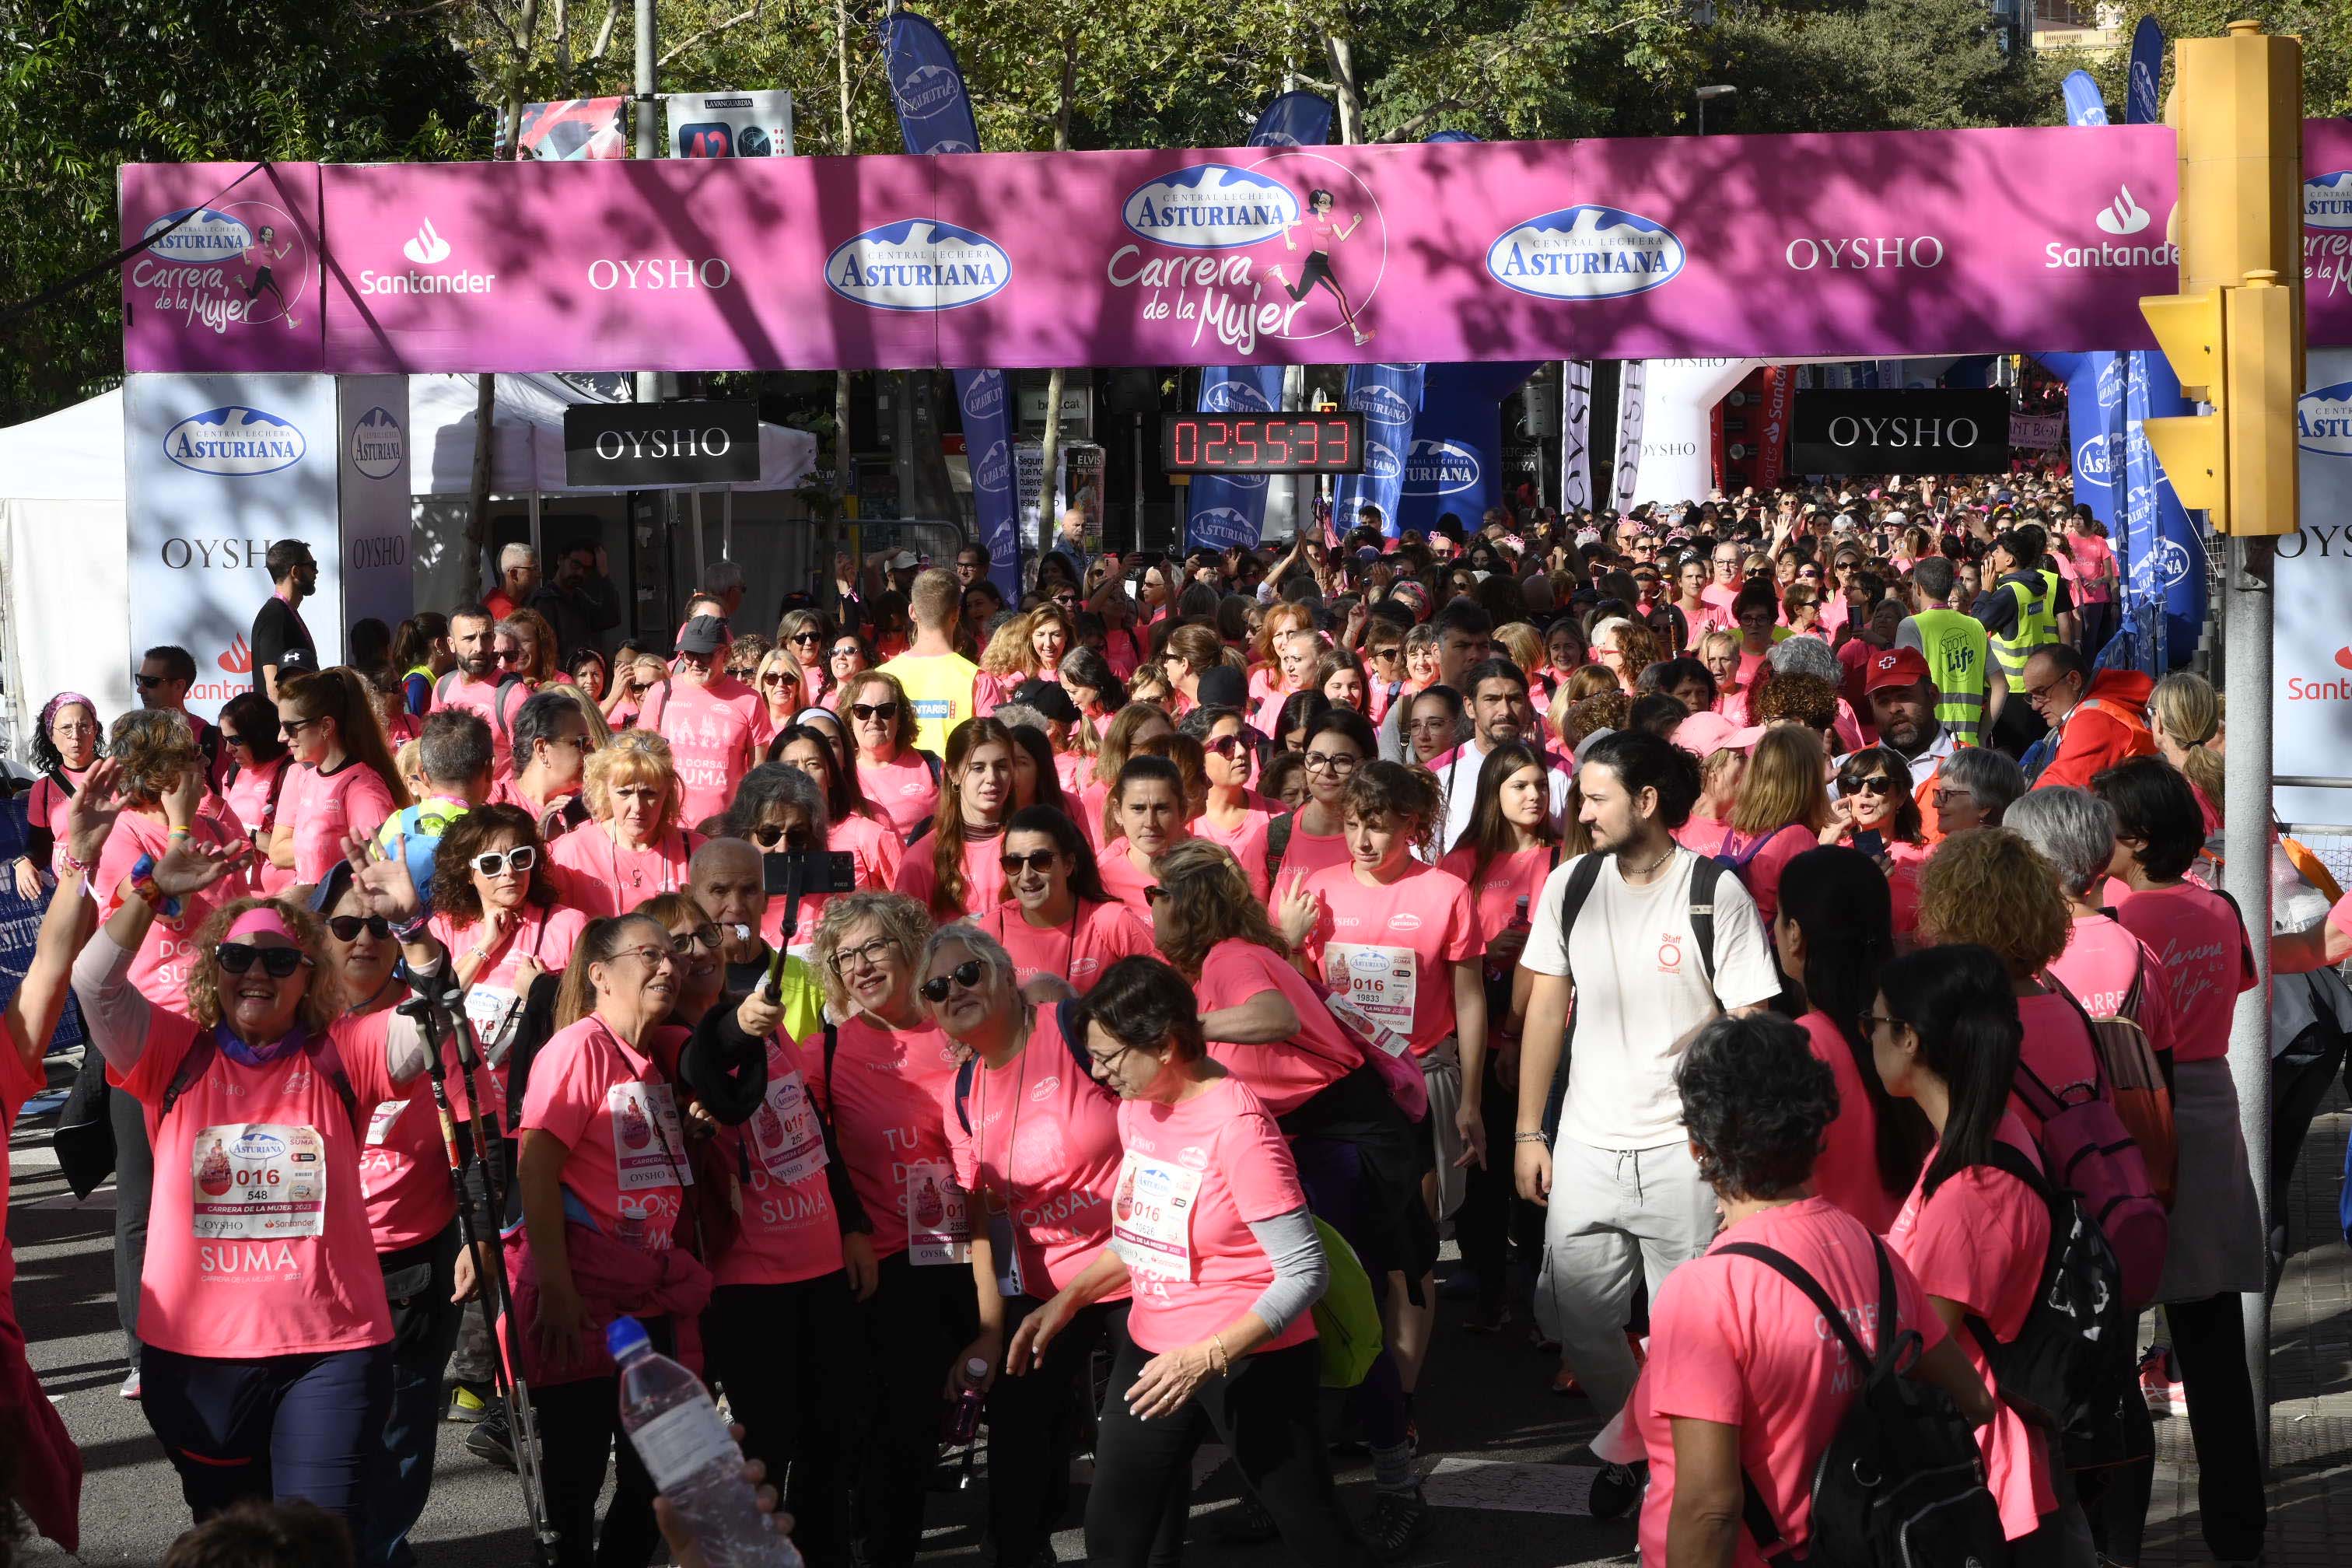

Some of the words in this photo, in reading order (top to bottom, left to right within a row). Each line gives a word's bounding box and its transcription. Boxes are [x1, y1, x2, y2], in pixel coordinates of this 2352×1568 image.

[1164, 193, 1218, 202] CENTRAL
[1223, 192, 1281, 201] LECHERA
[2304, 201, 2352, 215] STUR
[1136, 196, 1283, 227] ASTURIANA
[1532, 238, 1594, 248] CENTRAL
[1599, 236, 1663, 247] LECHERA
[1786, 235, 1944, 270] OYSHO
[867, 250, 926, 259] CENTRAL
[932, 249, 991, 259] LECHERA
[1503, 241, 1669, 277] ASTURIANA
[2045, 241, 2179, 268] Santande
[132, 259, 224, 288] Carrera
[587, 257, 731, 290] OYSHO
[839, 253, 997, 287] ASTURIANA
[1108, 244, 1253, 288] Carrera
[2318, 257, 2332, 278] la
[360, 270, 495, 295] Santander
[155, 290, 172, 310] de
[176, 287, 188, 310] la
[185, 285, 259, 334] Mujer
[1143, 290, 1171, 320] de
[1176, 289, 1195, 320] la
[1192, 280, 1307, 355] Mujer
[595, 427, 730, 460] OYSHO
[1175, 422, 1349, 464] 02:55:33
[1566, 360, 1591, 508] OYSH
[1828, 416, 1979, 448] OYSHO
[174, 431, 296, 459] ASTURIANA
[355, 434, 400, 462] ASTURIANA
[1077, 454, 1101, 465] ELVIS
[1020, 468, 1032, 478] que
[1020, 478, 1044, 488] quiere
[1195, 518, 1254, 547] ASTURIANA
[161, 537, 272, 569] OYSH
[352, 535, 404, 570] OYSHO
[1941, 632, 1969, 655] Sport
[1947, 647, 1974, 673] Life
[912, 704, 947, 715] NTARIS
[686, 758, 728, 769] DORSAL
[683, 768, 727, 786] UMA
[1481, 879, 1510, 890] YSHO
[1661, 933, 1682, 944] Staff
[1353, 978, 1384, 992] 016
[1356, 993, 1380, 1003] 19833
[2081, 989, 2126, 1010] ARRE
[233, 1143, 282, 1153] ASTURIANA
[883, 1125, 919, 1152] TU
[236, 1169, 280, 1186] 016
[630, 1170, 666, 1183] OYSHO
[247, 1190, 268, 1201] 548
[761, 1190, 828, 1224] SUMA
[1016, 1183, 1101, 1227] ORSAL
[946, 1203, 964, 1217] 01
[1134, 1201, 1160, 1222] 016
[205, 1220, 243, 1230] OYSHO
[275, 1220, 316, 1228] Santander
[201, 1244, 299, 1273] SUMA
[921, 1248, 954, 1258] OYSHO
